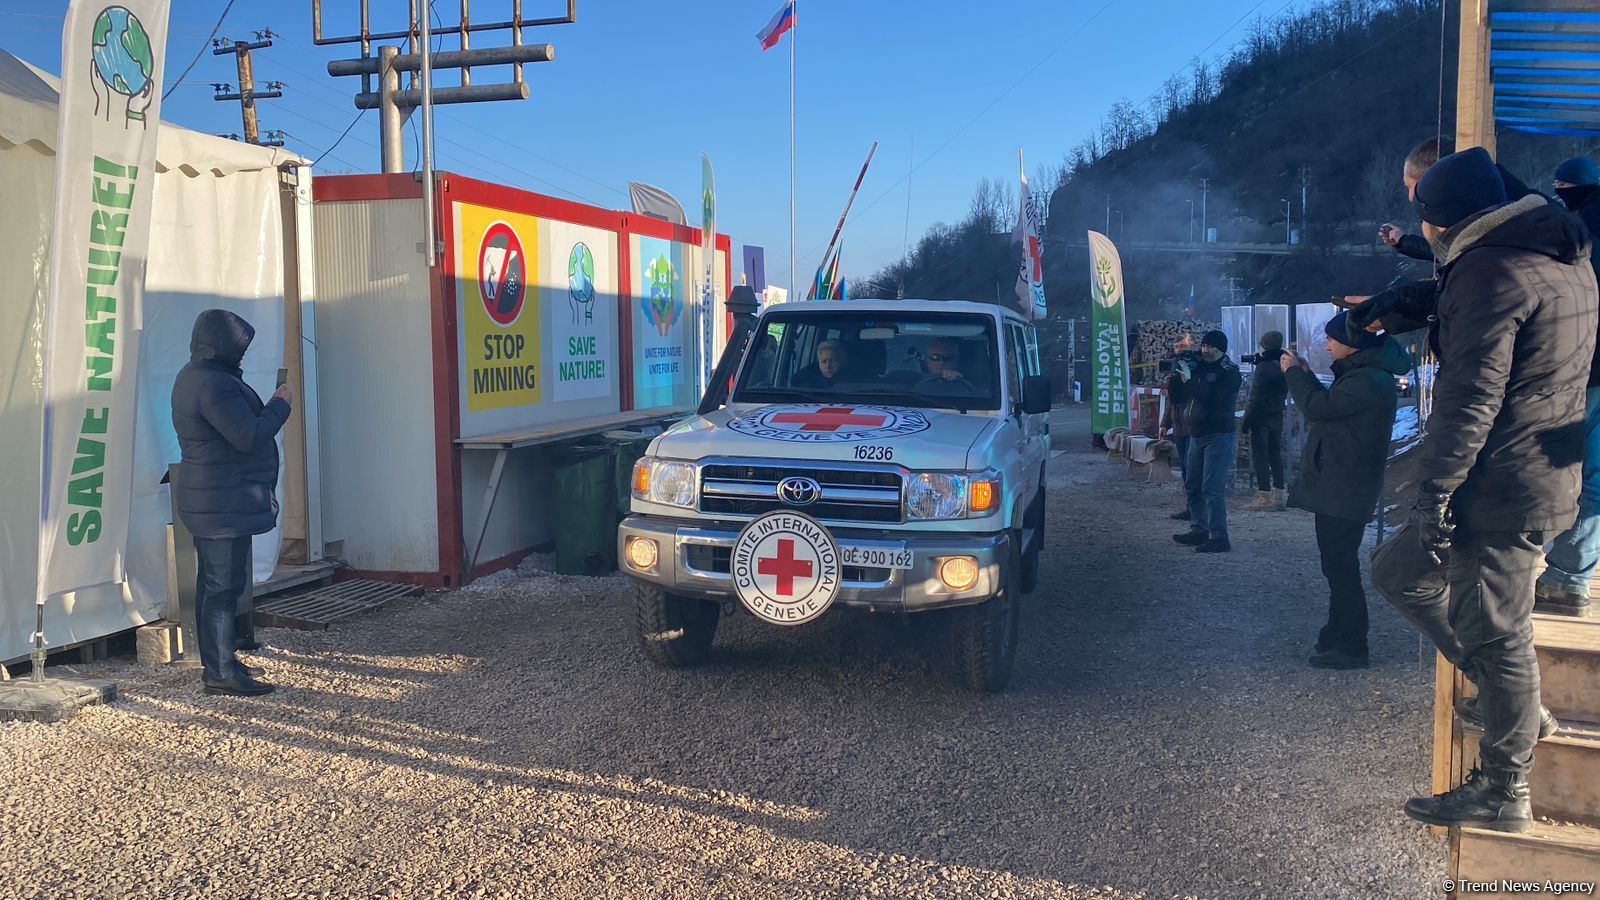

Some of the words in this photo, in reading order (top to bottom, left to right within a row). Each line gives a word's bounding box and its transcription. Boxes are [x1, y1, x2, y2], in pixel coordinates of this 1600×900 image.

[85, 155, 139, 391] NATURE!
[484, 334, 525, 360] STOP
[568, 336, 596, 356] SAVE
[473, 365, 535, 394] MINING
[560, 360, 605, 381] NATURE!
[754, 428, 880, 441] GENEVE
[853, 445, 894, 461] 16236
[67, 408, 109, 546] SAVE
[737, 531, 759, 588] COMITE
[757, 517, 836, 594] INTERNATIONAL
[752, 595, 819, 619] GENEVE
